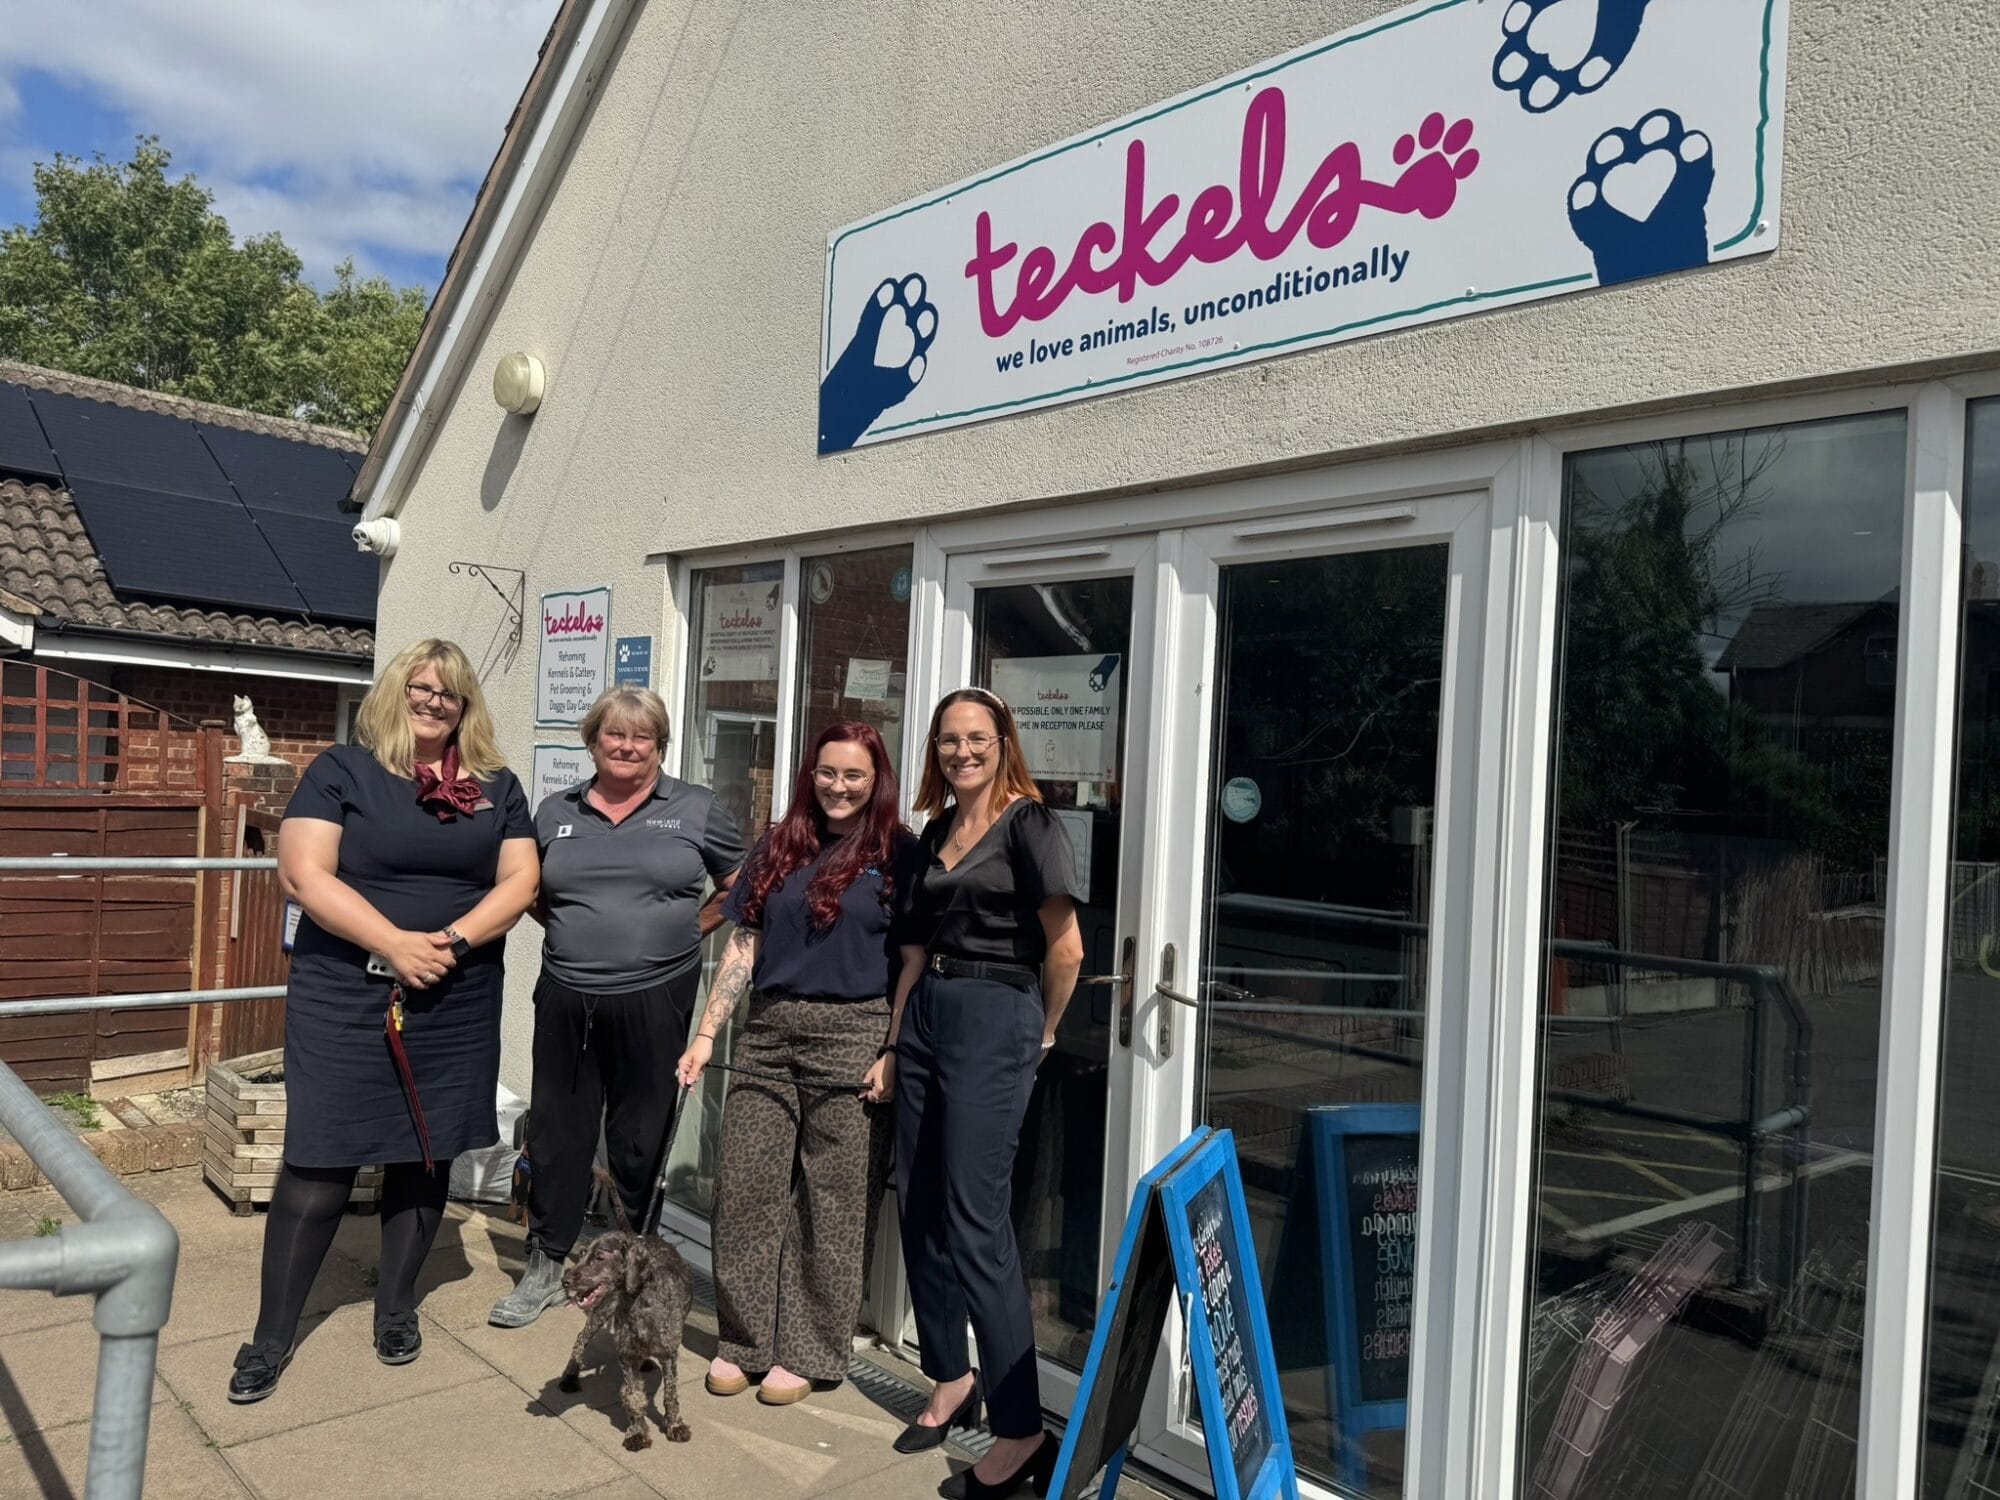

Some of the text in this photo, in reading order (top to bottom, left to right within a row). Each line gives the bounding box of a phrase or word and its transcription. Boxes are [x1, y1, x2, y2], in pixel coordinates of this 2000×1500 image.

[964, 87, 1364, 338] teckels
[996, 244, 1409, 373] we love animals, unconditionally
[1126, 351, 1160, 366] Registered
[1160, 346, 1185, 358] Charity
[544, 600, 596, 635] teckels
[558, 651, 586, 664] Rehoming
[548, 666, 596, 680] Kennels & Cattery
[549, 682, 592, 697] Pet Grooming &
[549, 699, 592, 713] Doggy Day Care
[1051, 706, 1069, 715] ONLY
[1070, 706, 1084, 715] ONE
[1085, 706, 1111, 714] FAMILY
[1016, 721, 1104, 730] TIME IN RECEPTION PLEASE
[553, 758, 579, 773] Rehoming
[543, 773, 562, 784] Kennels
[563, 774, 568, 785] &
